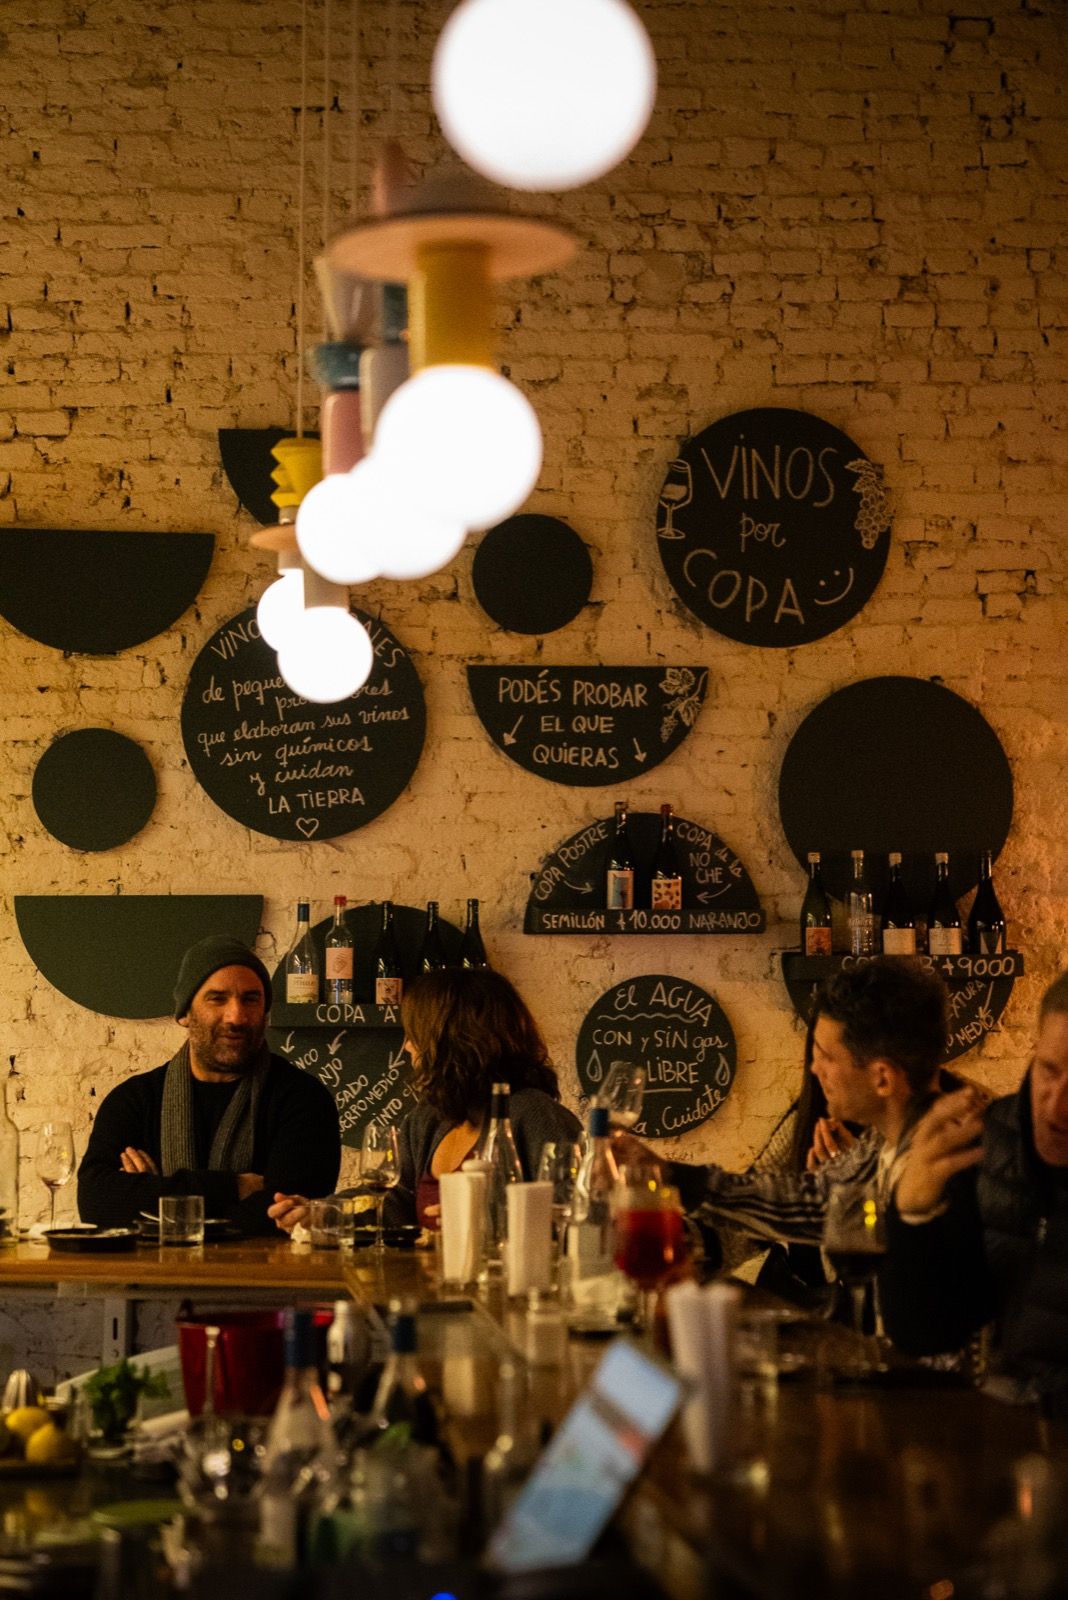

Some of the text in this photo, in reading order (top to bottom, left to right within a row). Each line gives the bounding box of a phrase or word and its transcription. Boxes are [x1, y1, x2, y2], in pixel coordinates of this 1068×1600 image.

[701, 433, 839, 507] VINOS
[740, 512, 786, 552] por
[683, 549, 804, 624] COPA
[210, 618, 262, 661] VINO
[202, 675, 285, 712] de peque
[498, 669, 648, 708] PODÉS PROBAR
[197, 704, 411, 757] que elaboran sus vinos
[540, 715, 616, 734] EL QUE
[220, 735, 374, 768] sin químicos
[532, 741, 620, 769] QUIERAS
[249, 760, 354, 796] y cuidan
[268, 787, 366, 815] LA TIERRA
[676, 822, 713, 851] COPA
[534, 821, 609, 901] COPA POSTRE
[689, 852, 711, 868] NO
[695, 867, 724, 885] CHE
[689, 911, 761, 932] NARANJO
[316, 1004, 366, 1023] COPA
[614, 981, 712, 1027] El AGUA
[592, 1026, 728, 1063] CON y SIN gas
[365, 1068, 399, 1105] MEDIO
[646, 1056, 699, 1084] LIBRE
[334, 1075, 369, 1112] SADO
[662, 1084, 726, 1131] Cuidate
